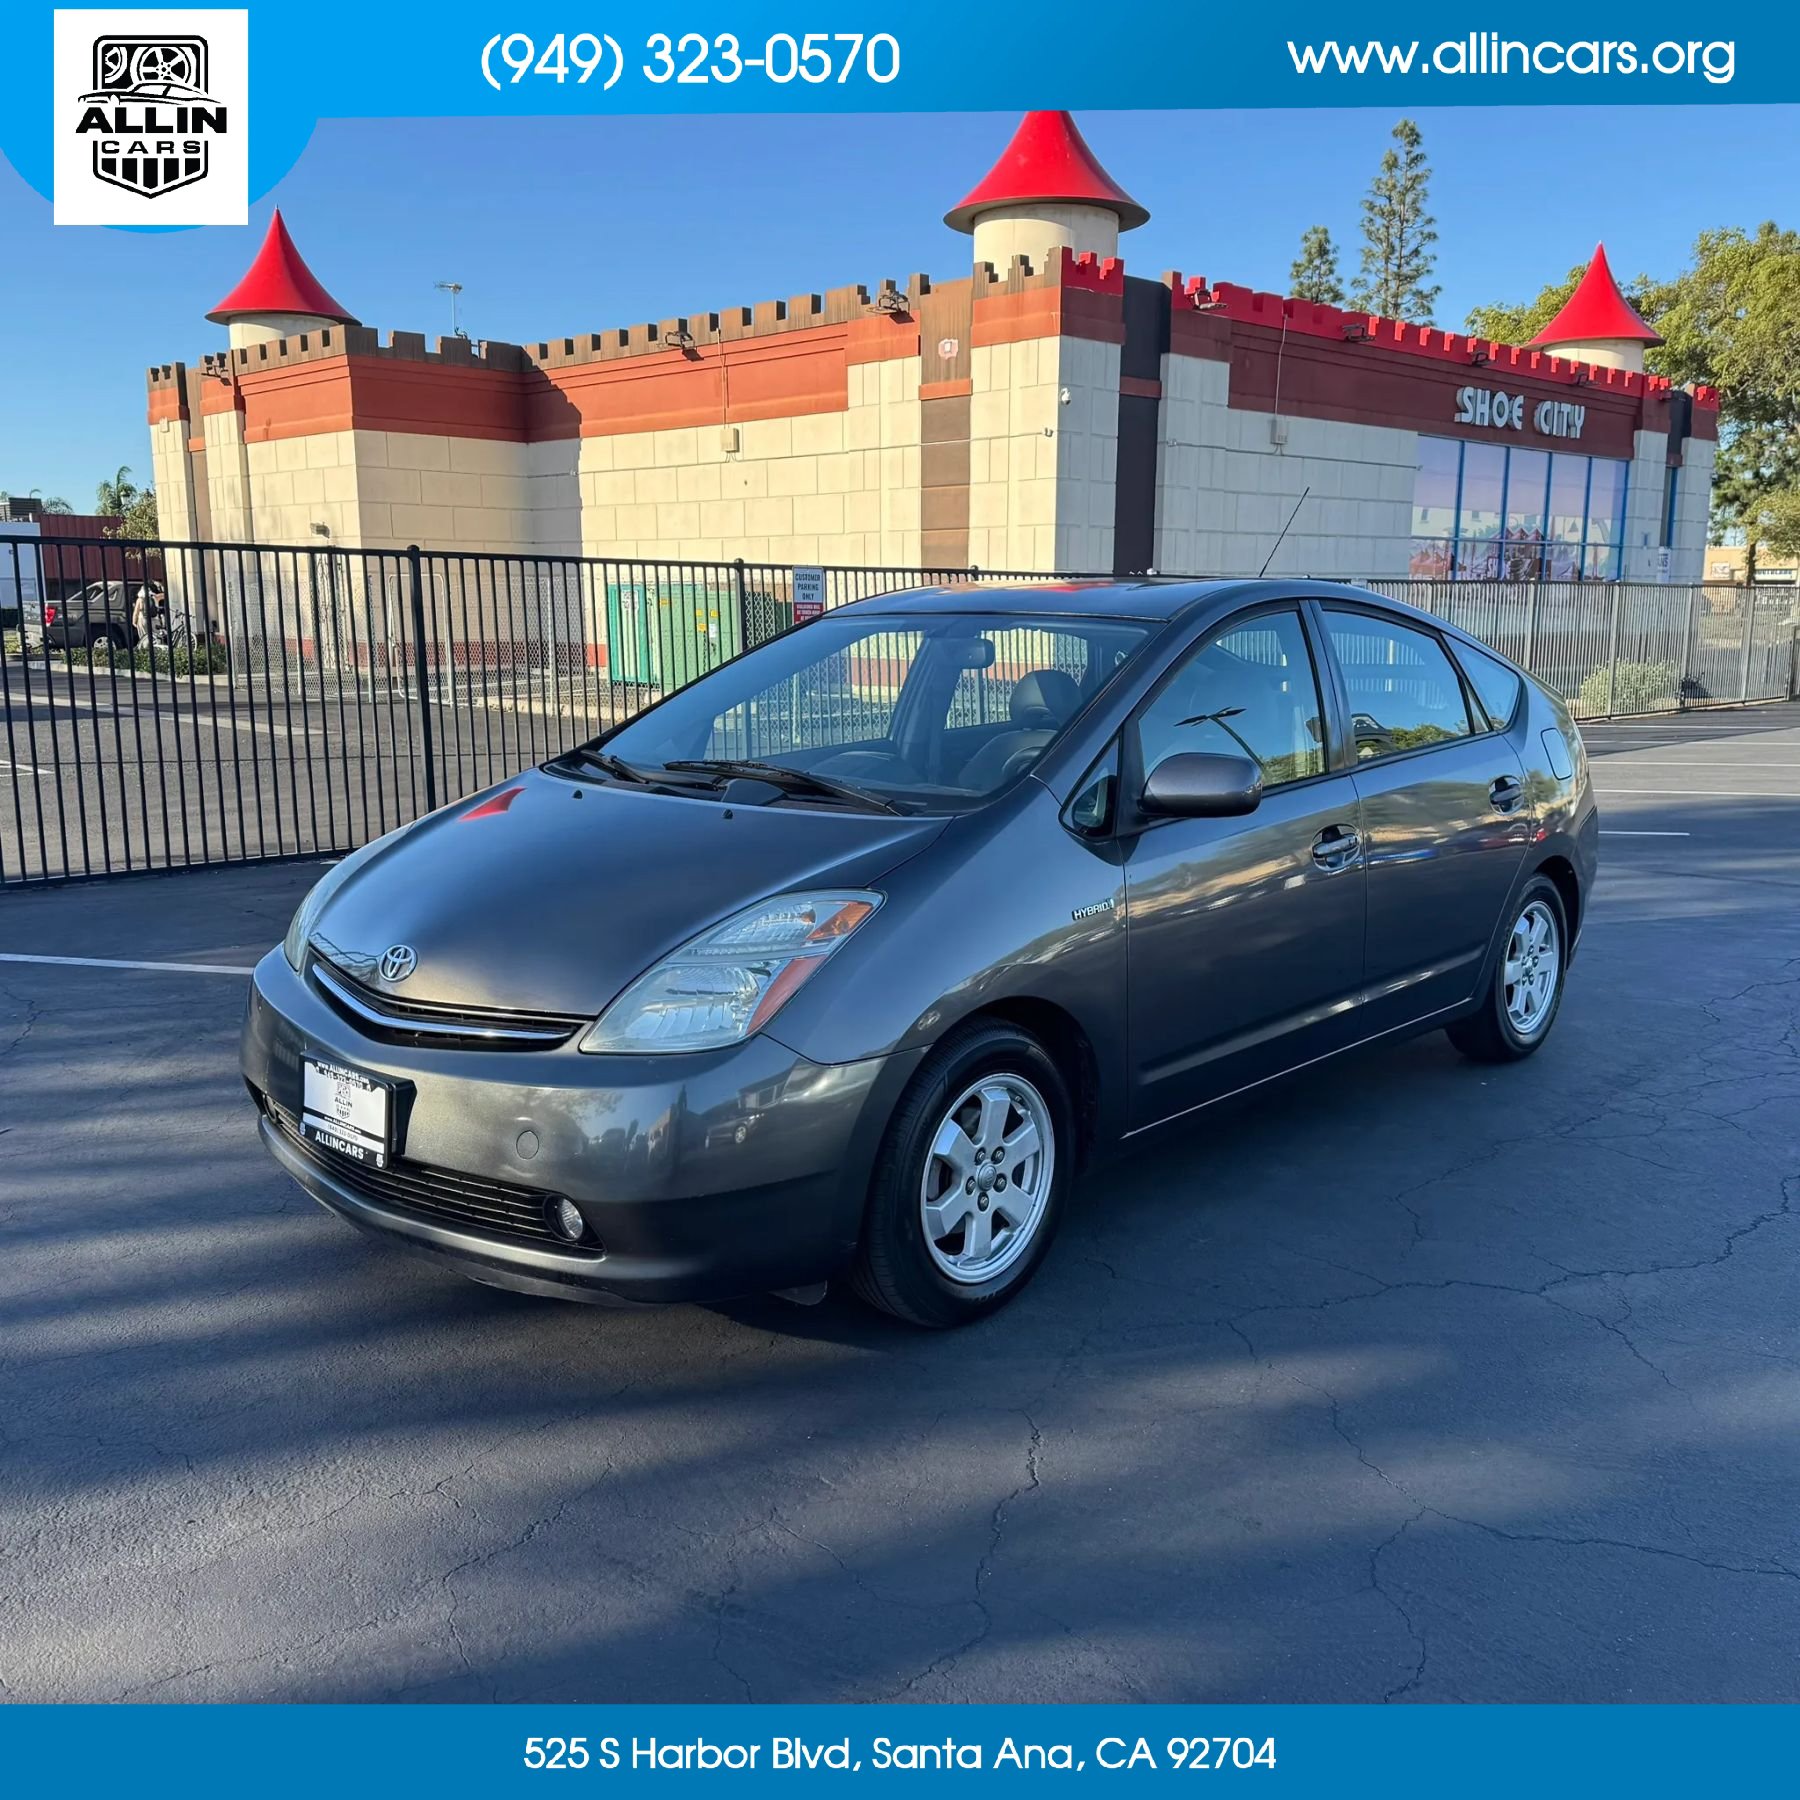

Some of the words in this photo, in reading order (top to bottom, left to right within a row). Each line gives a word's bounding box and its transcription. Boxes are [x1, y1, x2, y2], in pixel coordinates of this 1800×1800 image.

[1454, 386, 1524, 430] SHOE
[1535, 400, 1585, 438] CITY
[794, 573, 820, 582] CUSTOMER
[797, 583, 818, 591] PARKING
[1073, 901, 1110, 920] HYBRID
[315, 1130, 364, 1160] ALLINCARS
